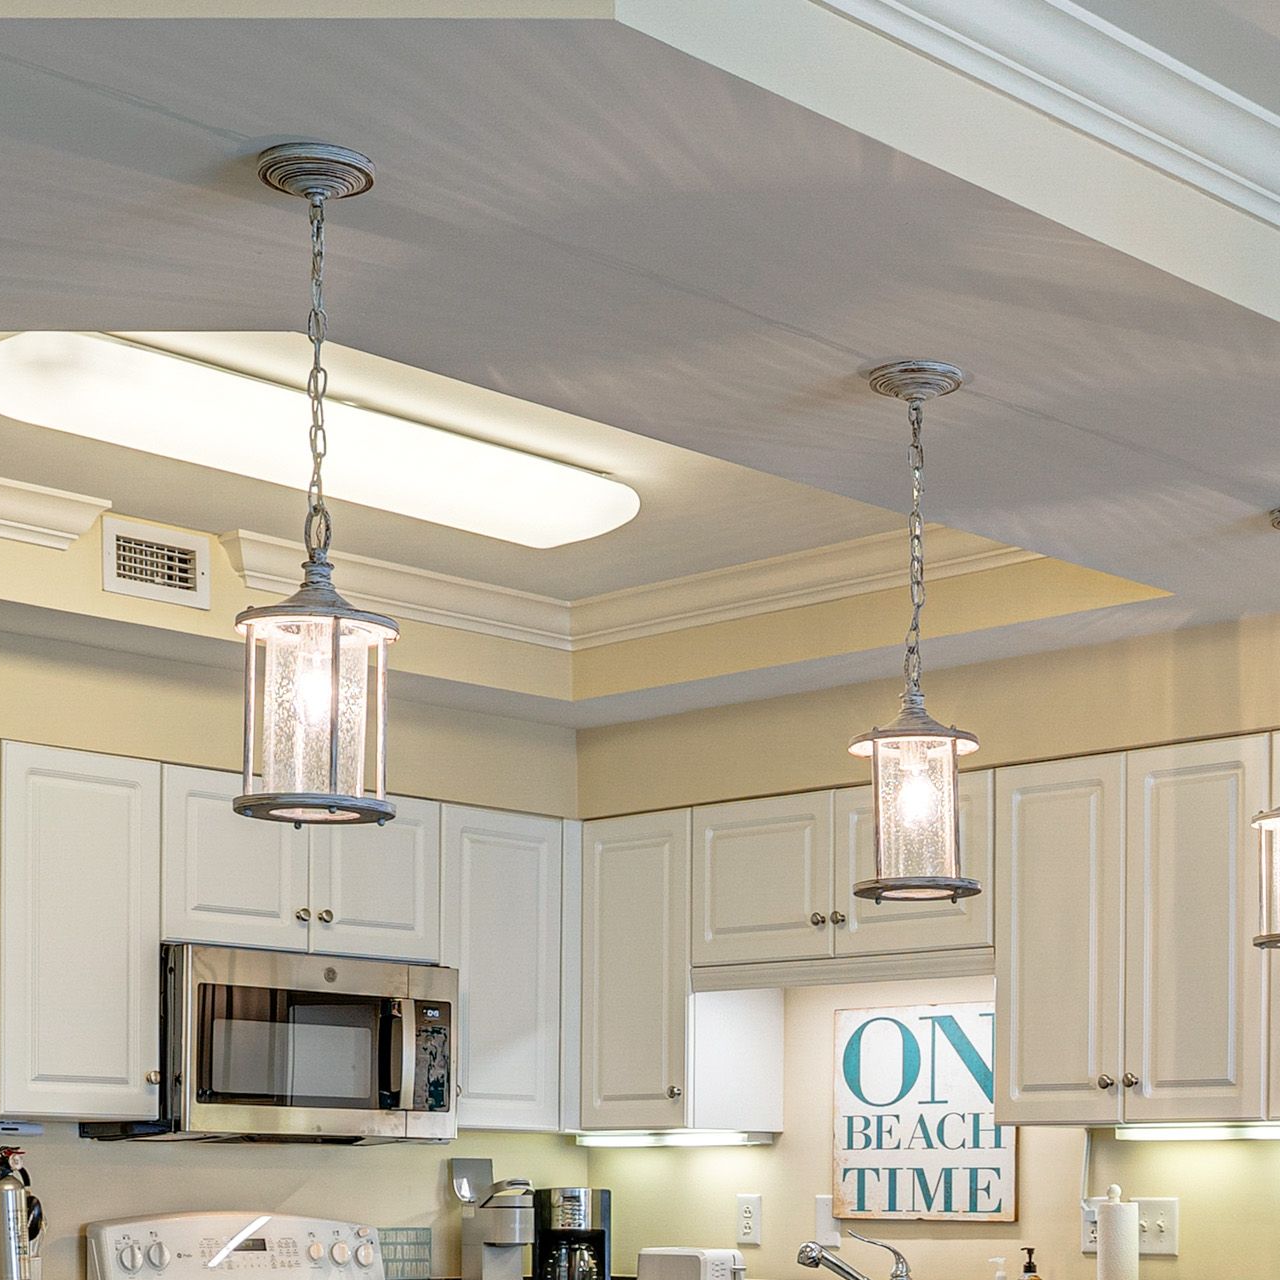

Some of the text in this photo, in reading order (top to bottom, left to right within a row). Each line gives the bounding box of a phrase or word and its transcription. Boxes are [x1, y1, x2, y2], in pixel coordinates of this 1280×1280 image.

[842, 1012, 996, 1108] ON
[842, 1112, 1007, 1151] BEACH
[842, 1167, 1003, 1213] TIME
